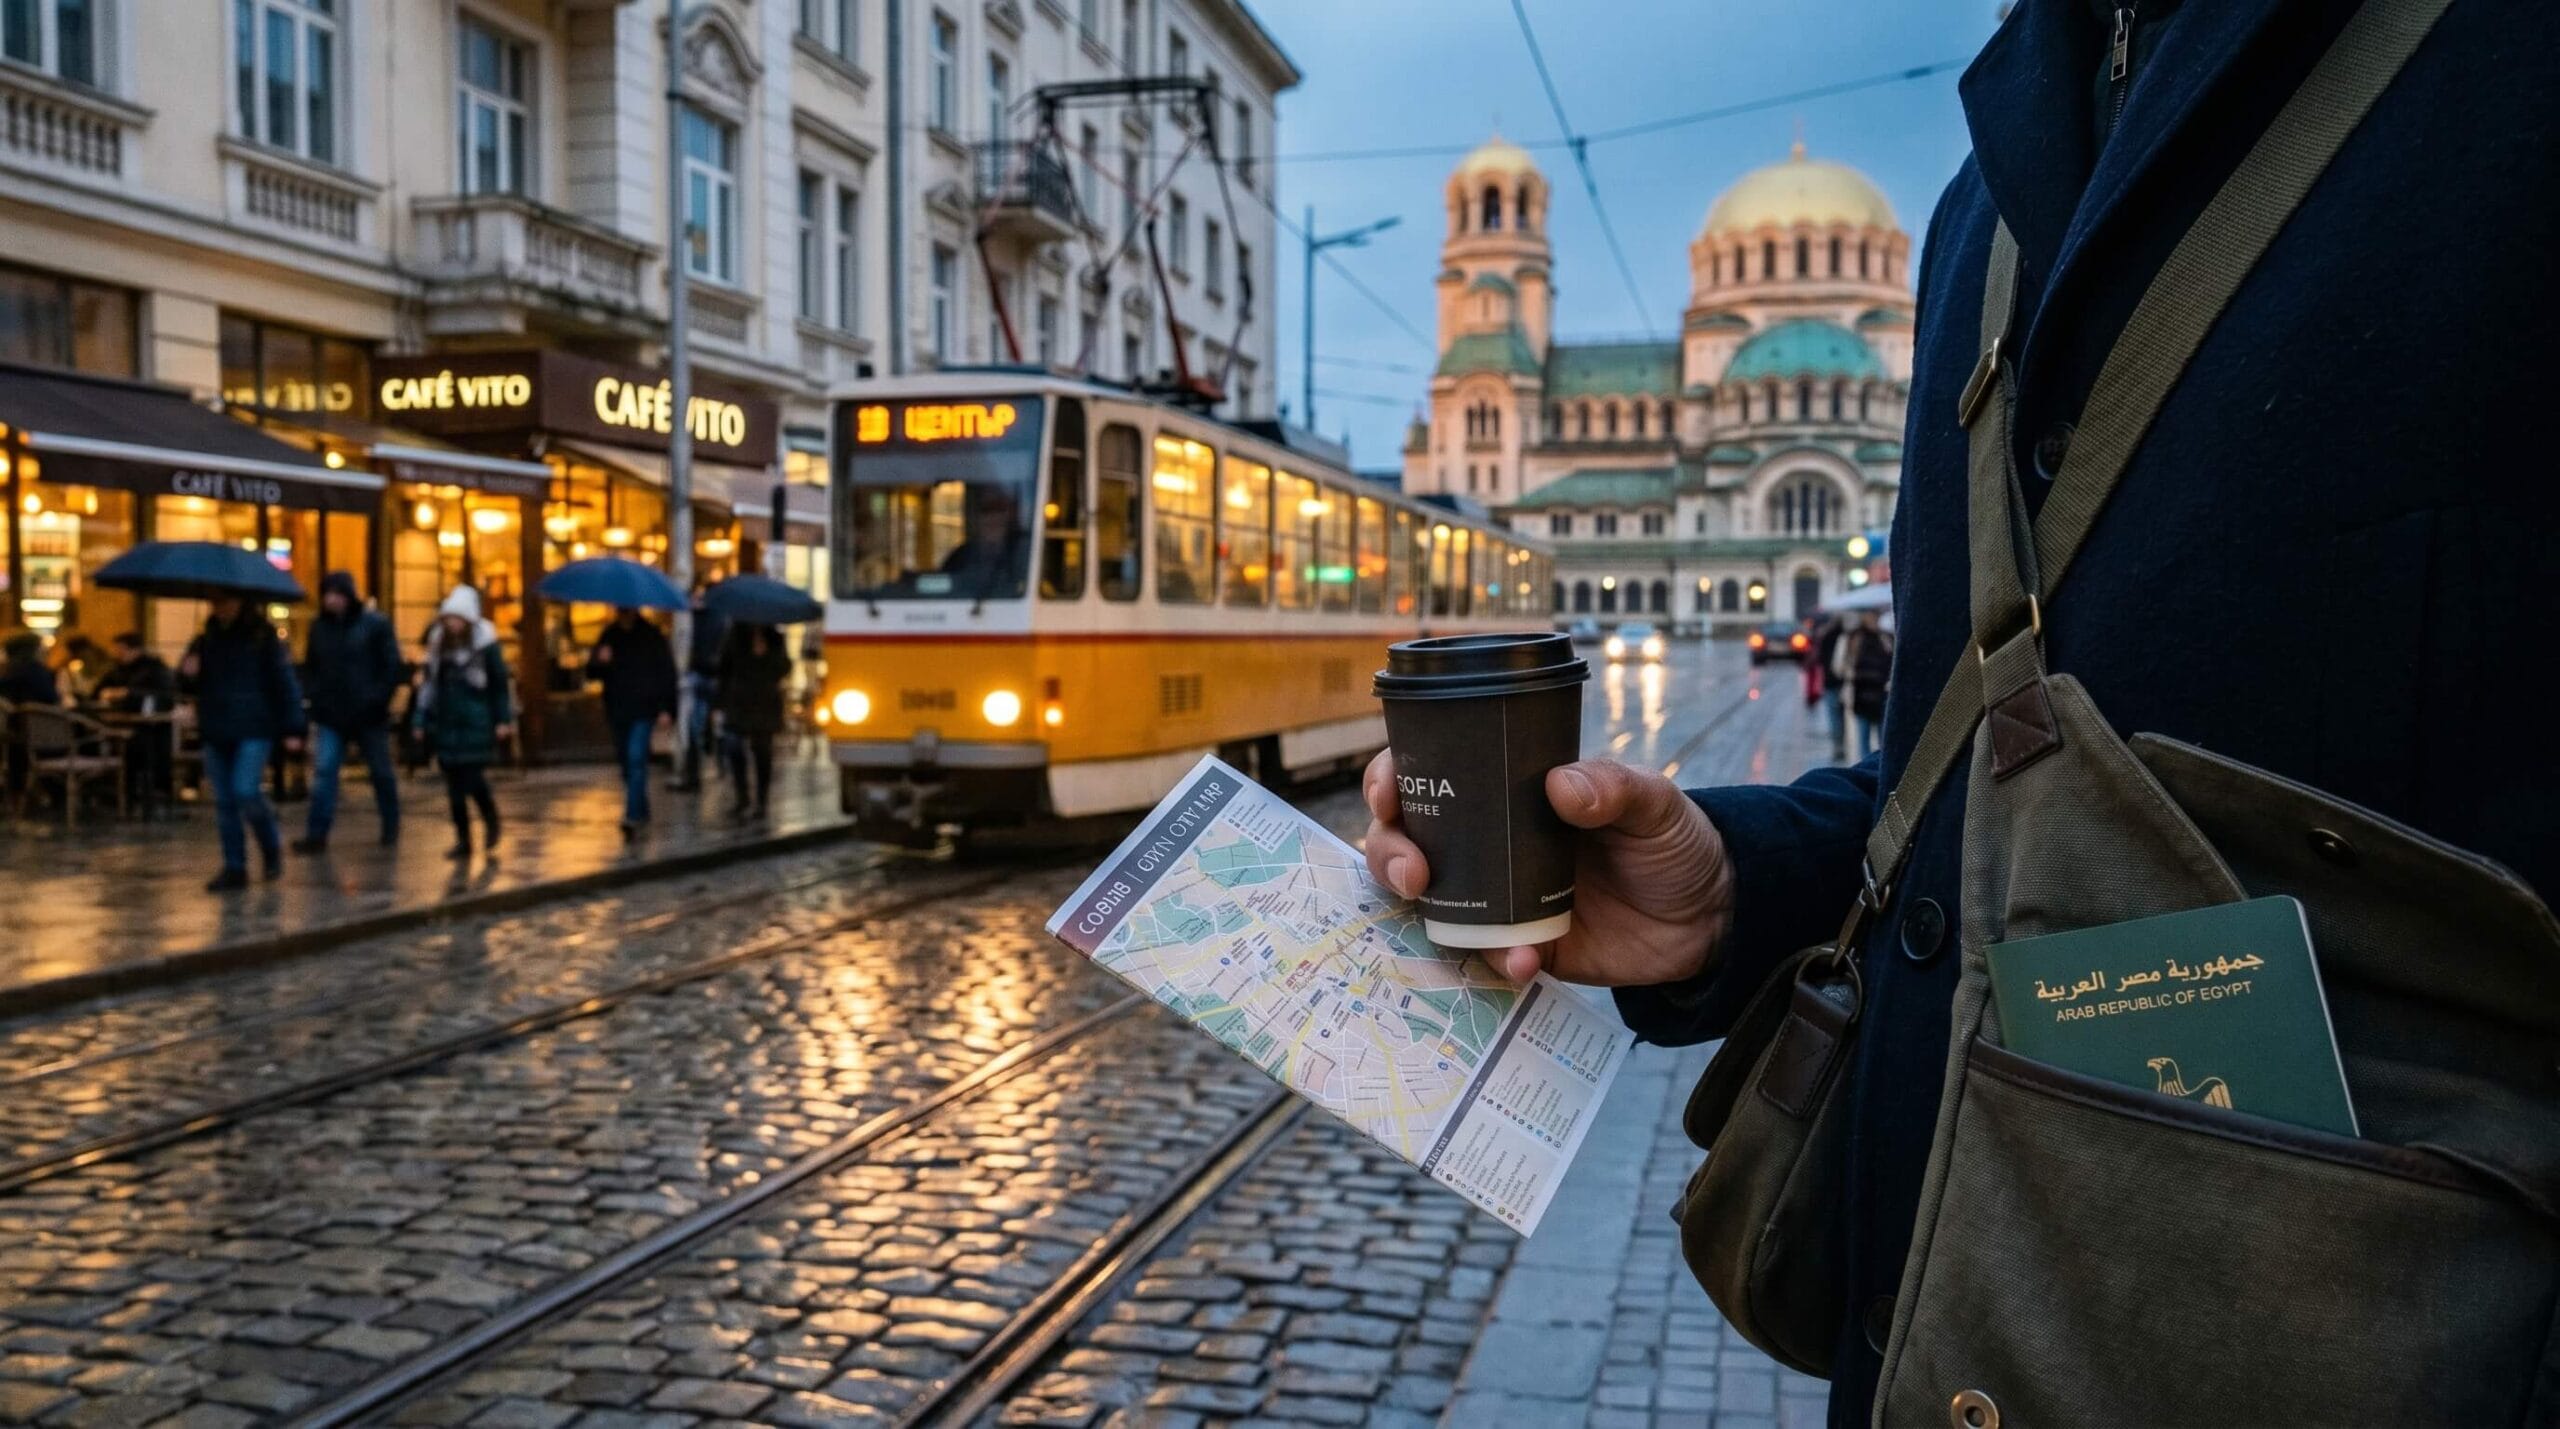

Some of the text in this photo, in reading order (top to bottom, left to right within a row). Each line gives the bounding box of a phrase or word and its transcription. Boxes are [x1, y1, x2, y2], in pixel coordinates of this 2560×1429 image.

[381, 370, 454, 410] CAFÉ
[457, 374, 531, 408] VITO
[594, 376, 672, 434] CAFÉ
[1396, 774, 1456, 798] SOFIA
[2034, 953, 2265, 1002] جمهورية مصر العربية
[2055, 981, 2252, 1023] ARAB REPUBLIC OF EGYPT
